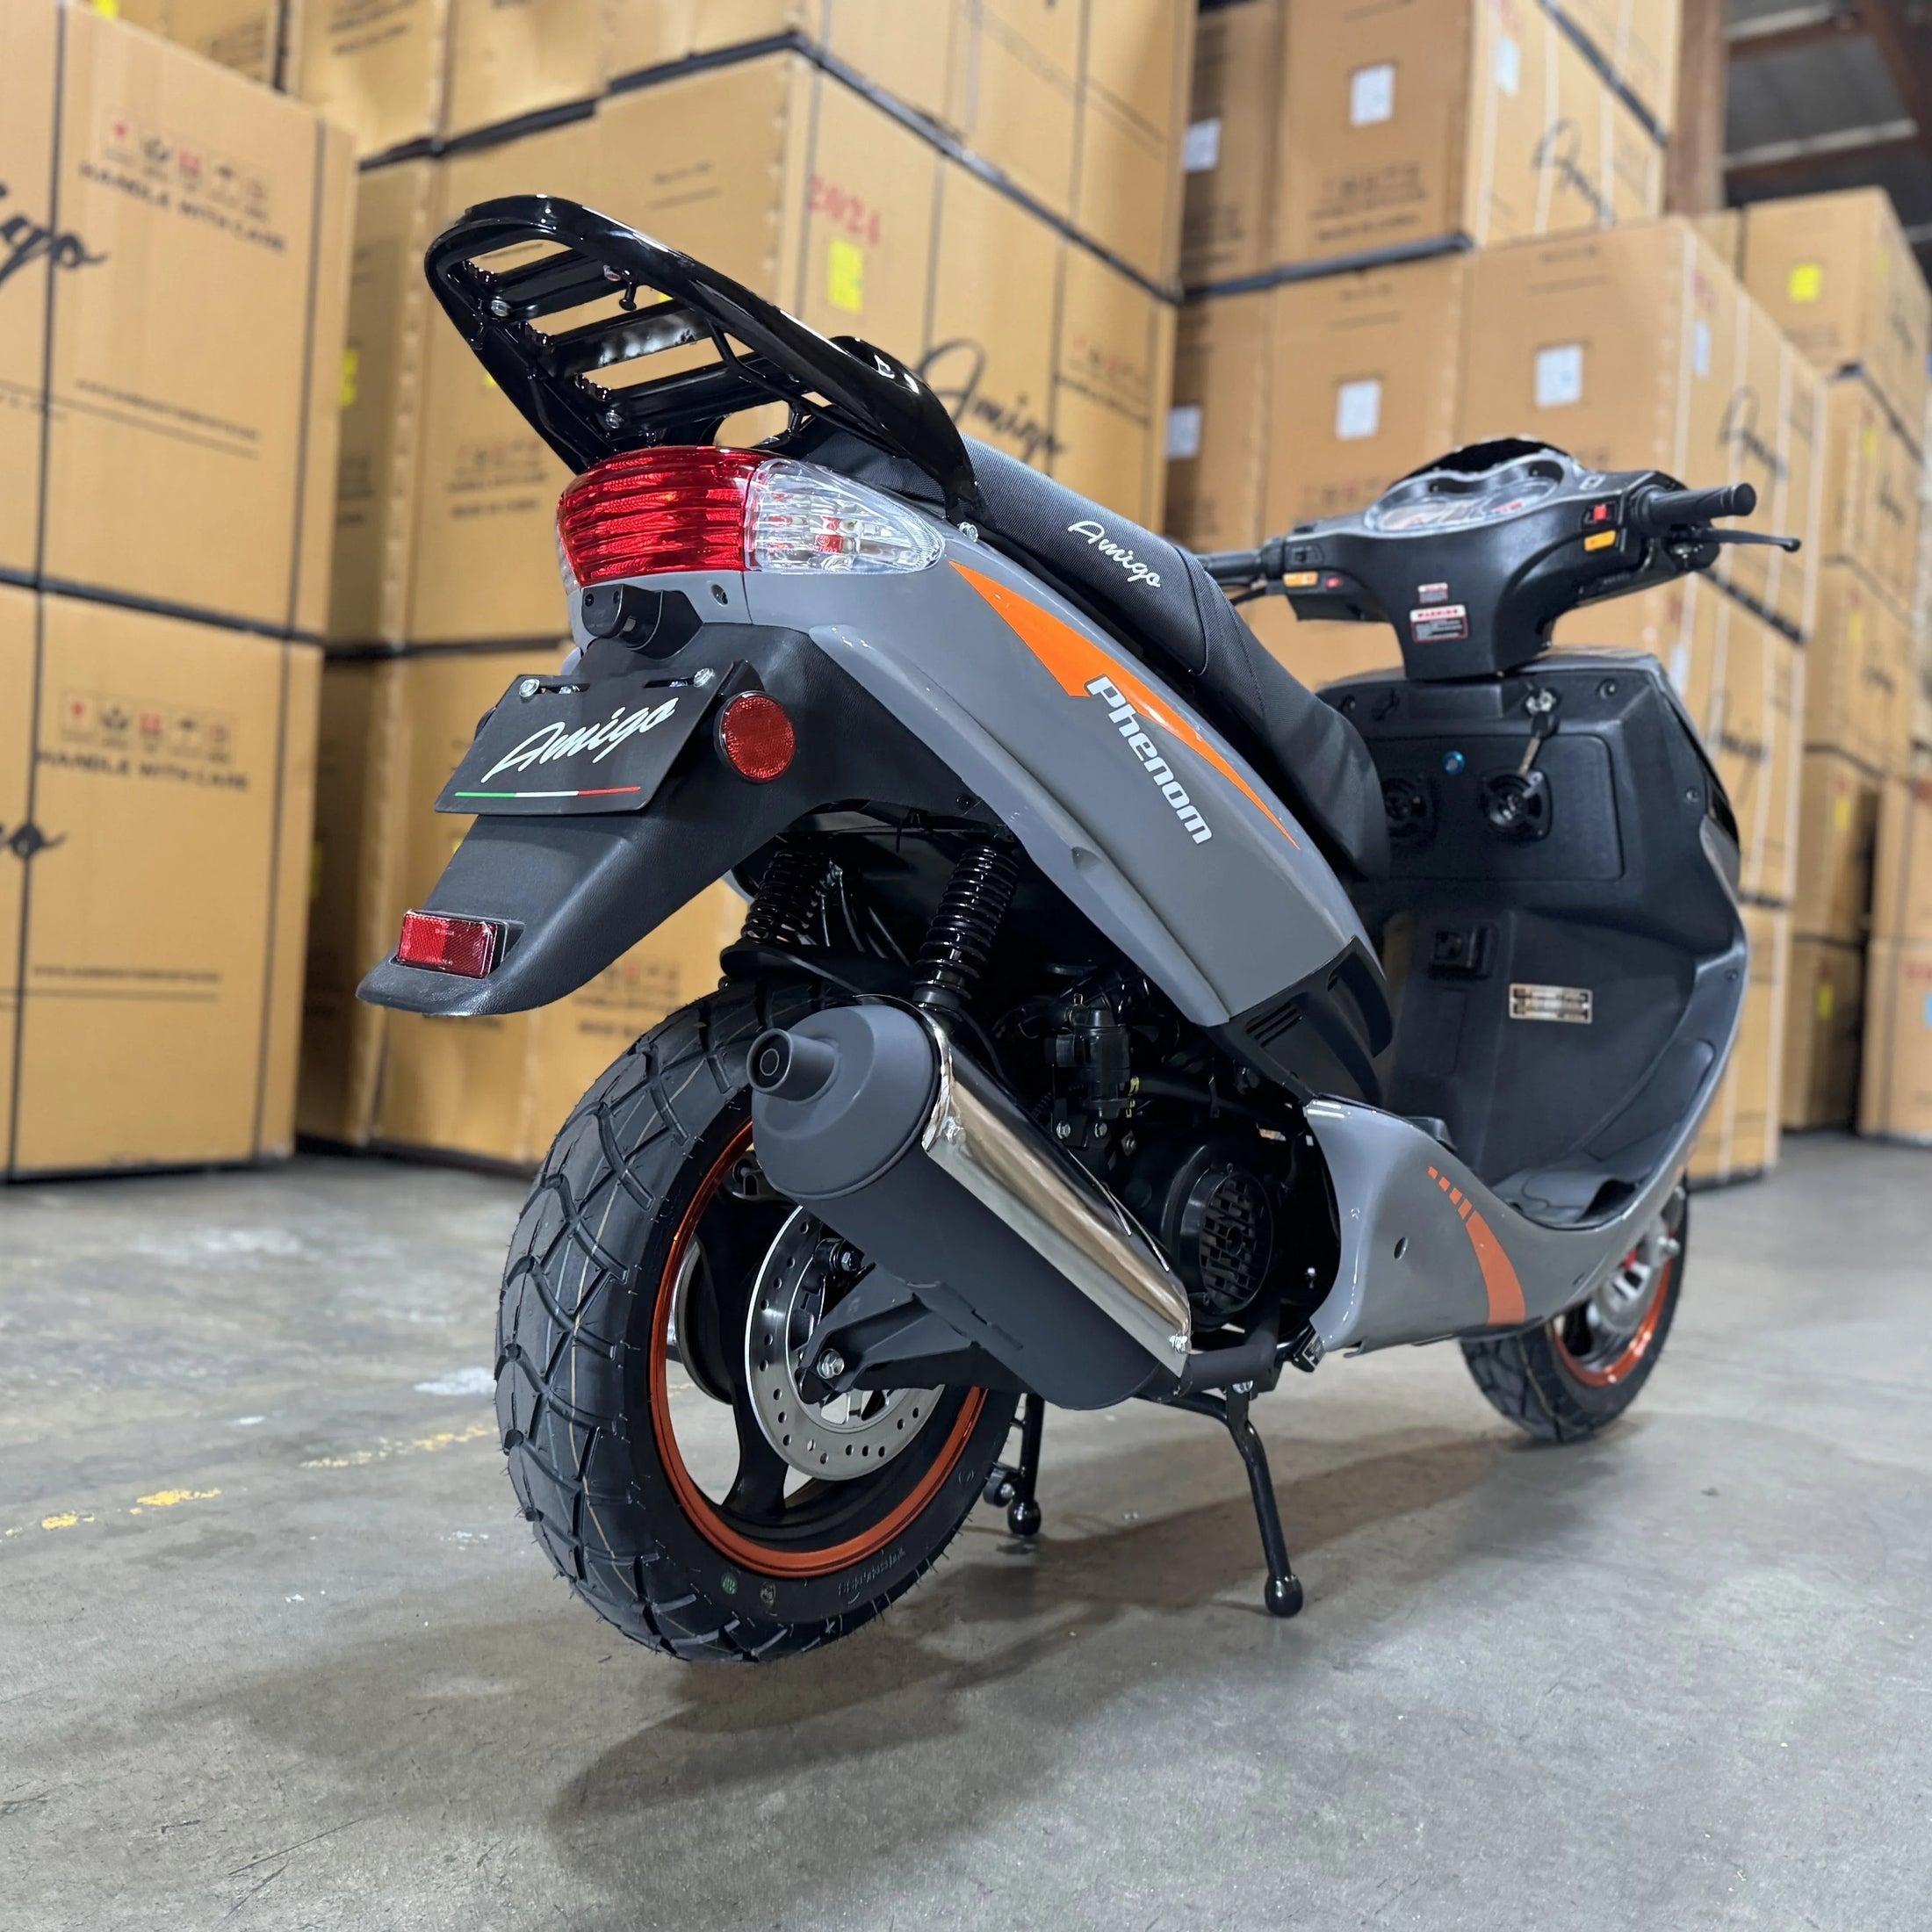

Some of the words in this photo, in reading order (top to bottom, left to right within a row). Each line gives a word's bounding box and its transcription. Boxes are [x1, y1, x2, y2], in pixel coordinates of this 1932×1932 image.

[1068, 520, 1161, 588] Amigo
[480, 697, 680, 783] Amigo
[1085, 675, 1213, 845] Phenom
